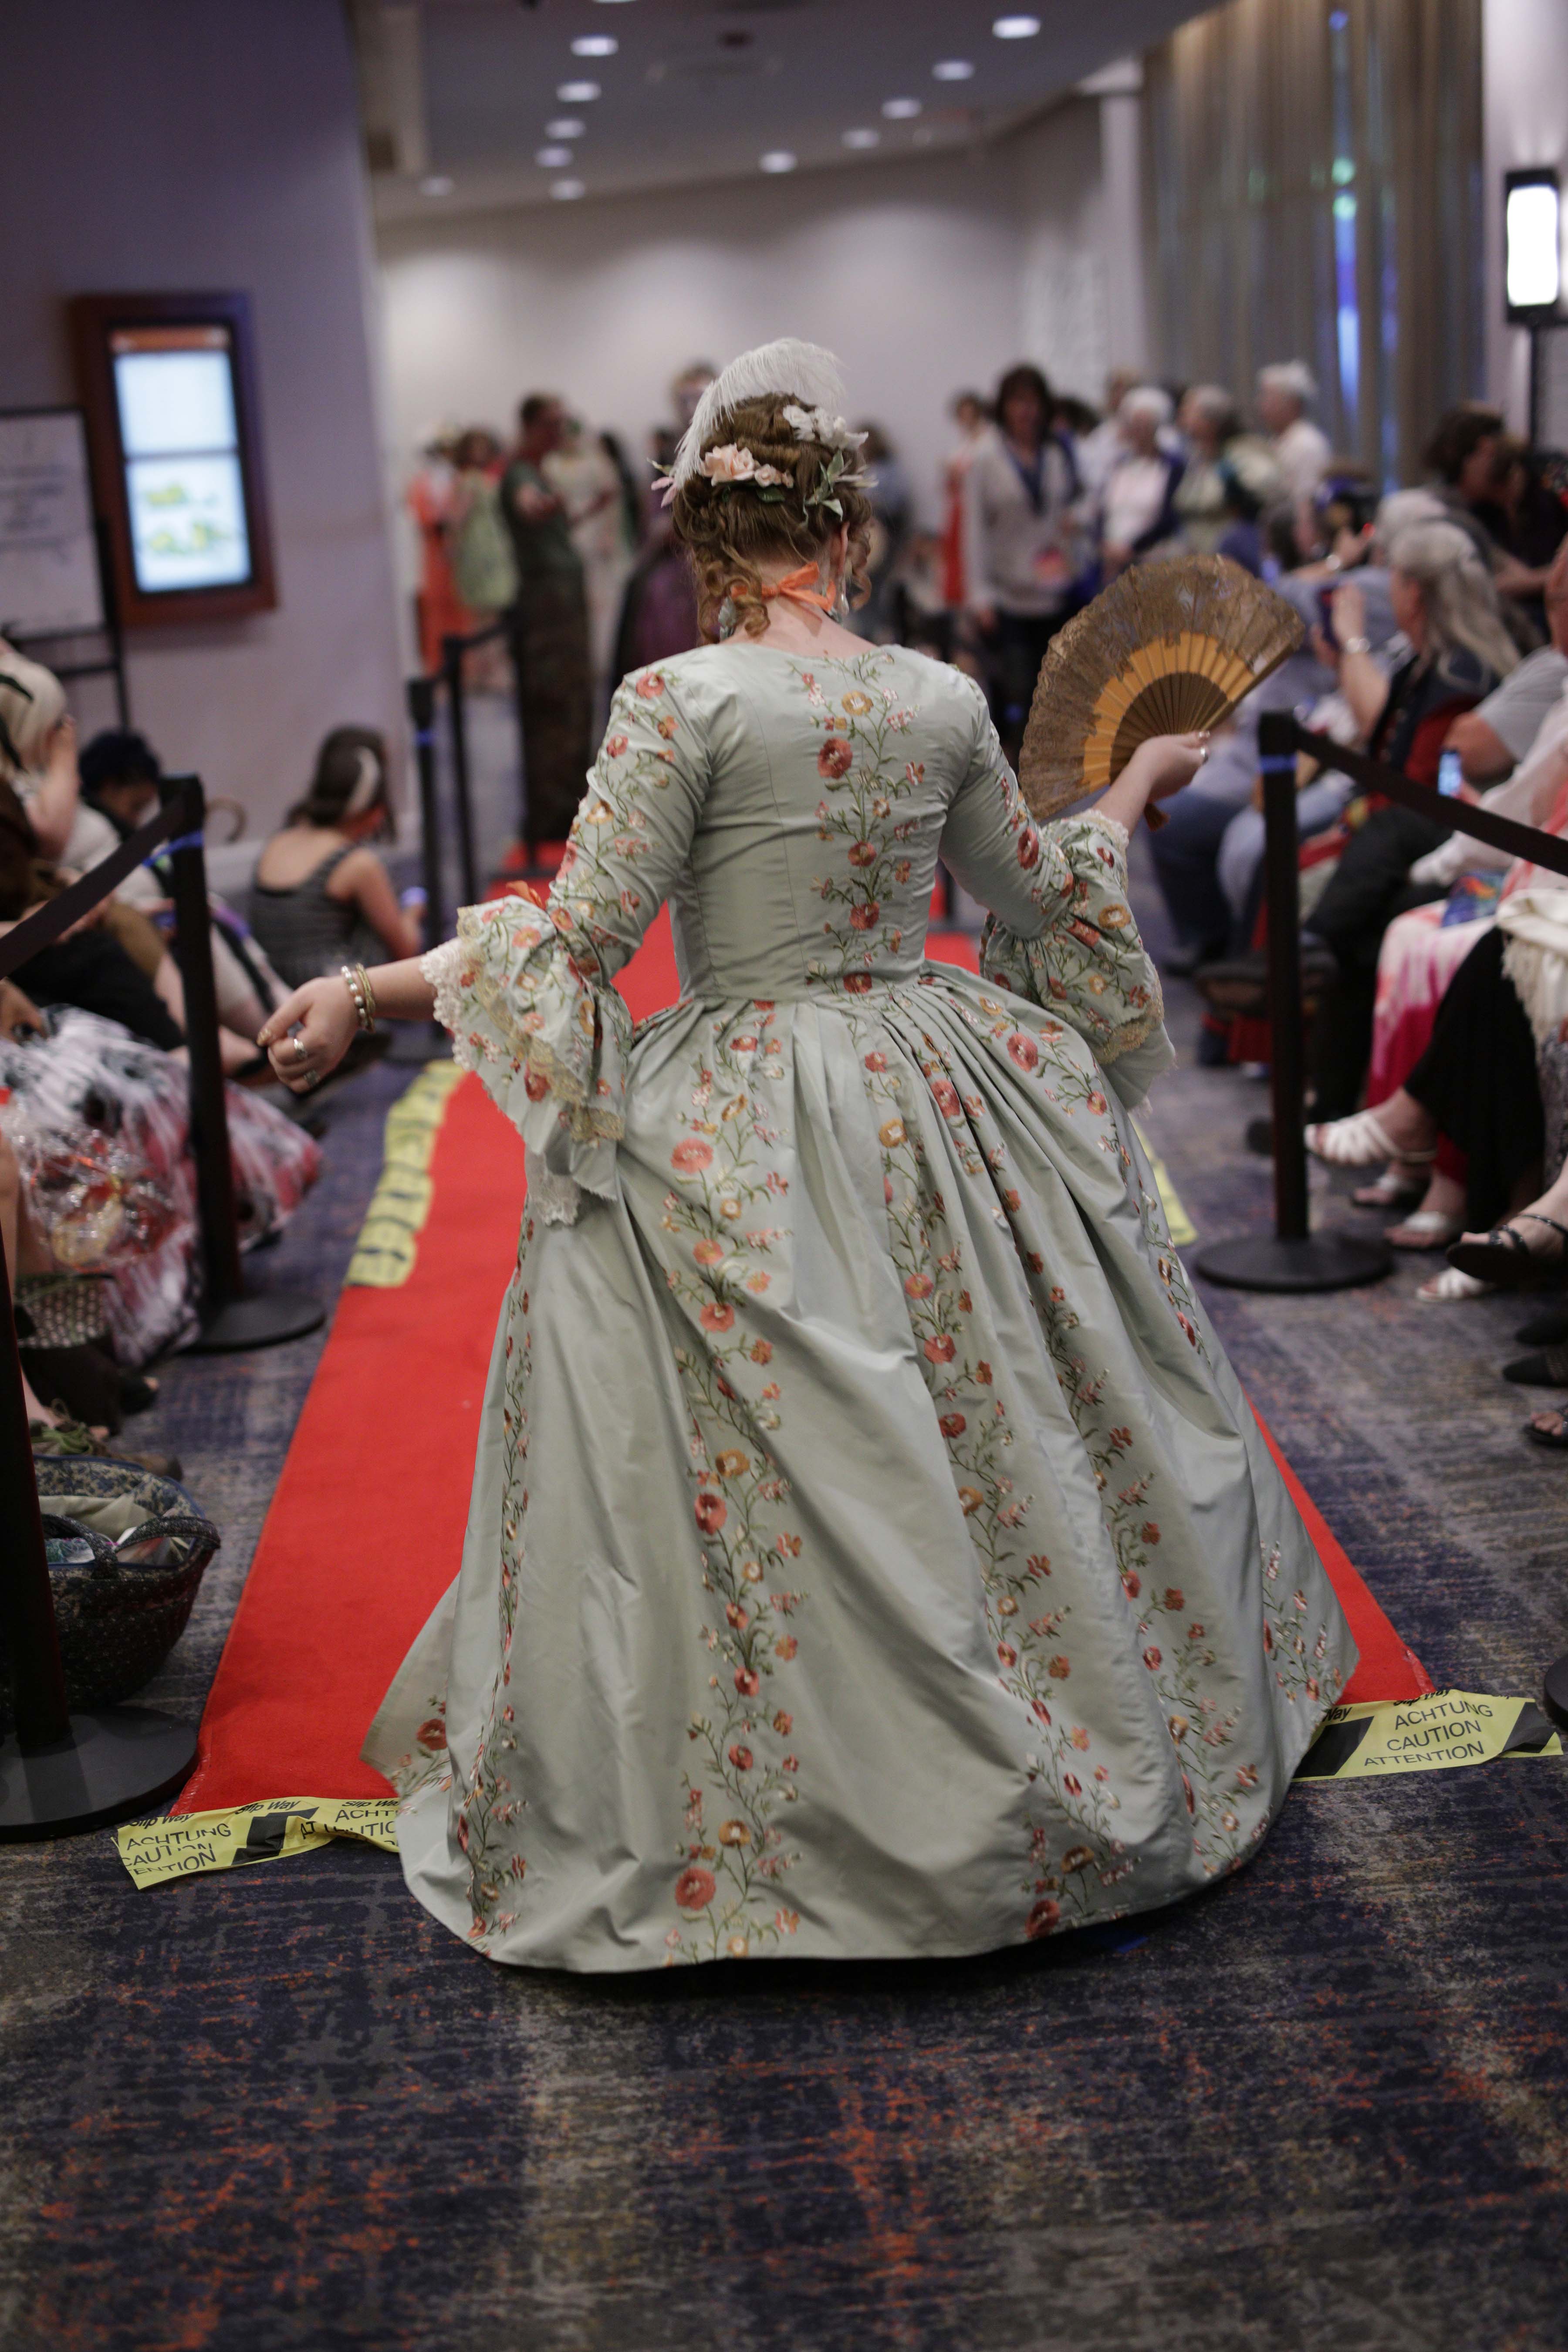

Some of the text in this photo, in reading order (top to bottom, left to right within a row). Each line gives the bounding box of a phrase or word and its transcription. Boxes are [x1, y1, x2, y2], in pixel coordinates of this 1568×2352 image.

[1395, 1700, 1493, 1730] ACHTUNG
[1387, 1720, 1482, 1751] CAUTION
[1364, 1740, 1485, 1766] ATTENTION
[267, 1800, 302, 1811] Way
[335, 1809, 399, 1823] ACHT
[127, 1823, 232, 1851] ACHTUNG
[128, 1849, 216, 1875] ENTION
